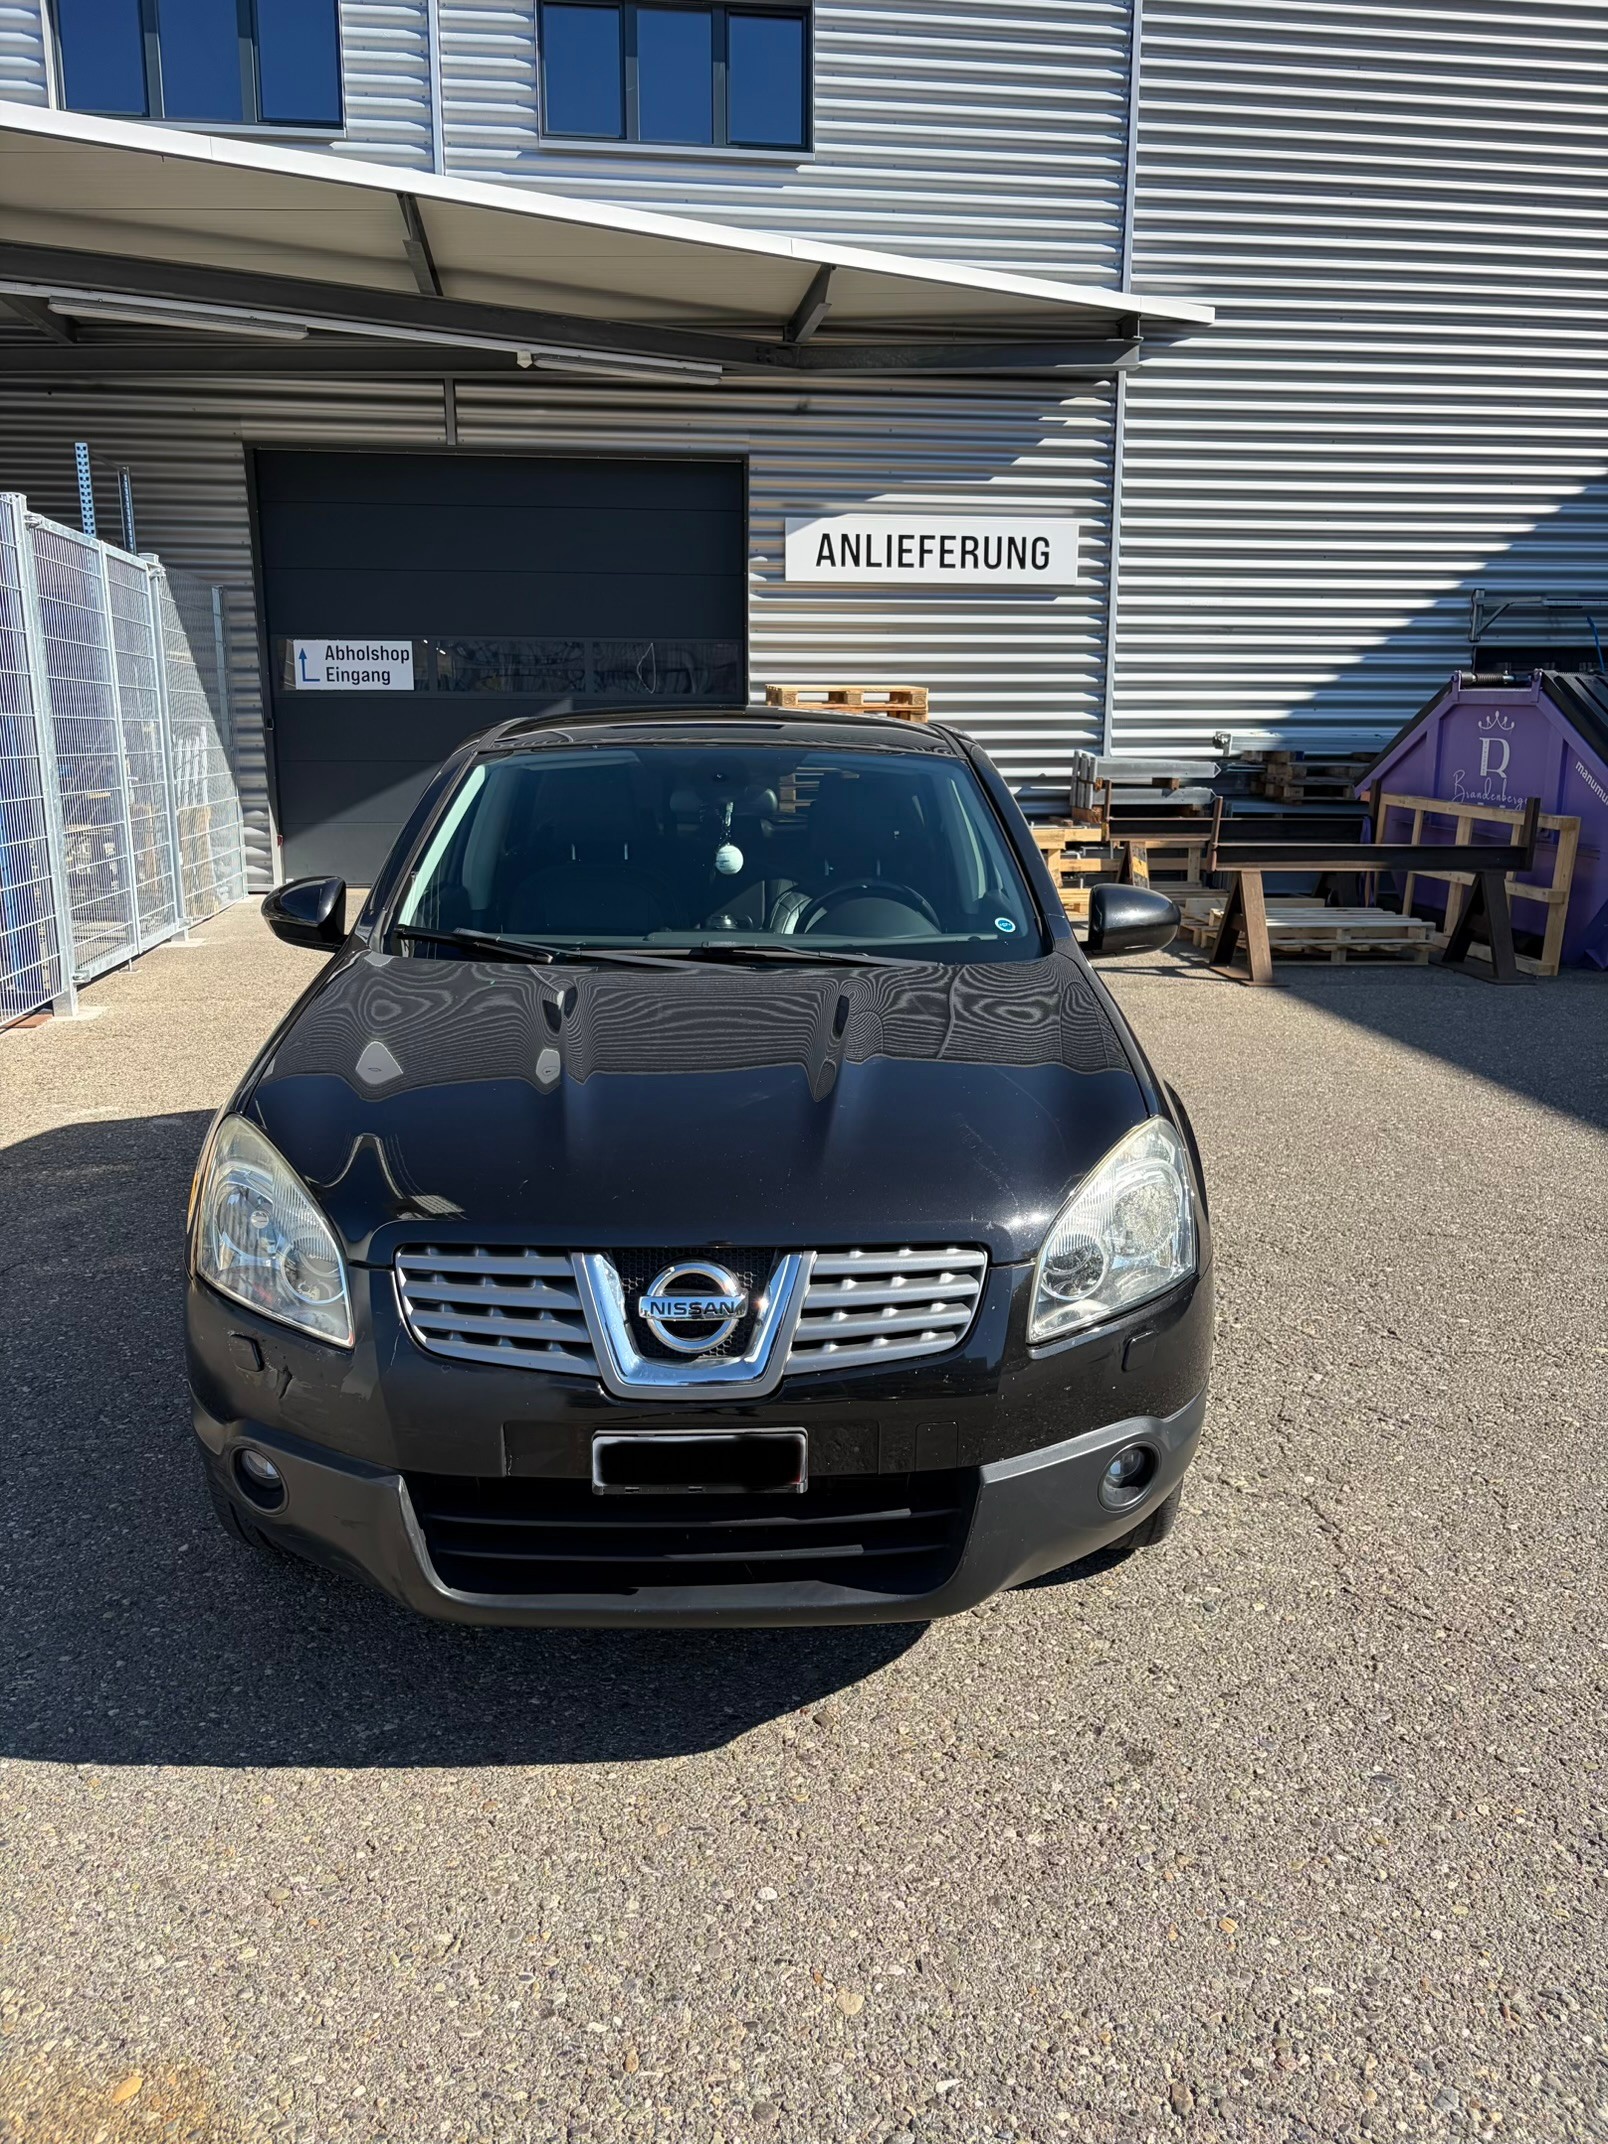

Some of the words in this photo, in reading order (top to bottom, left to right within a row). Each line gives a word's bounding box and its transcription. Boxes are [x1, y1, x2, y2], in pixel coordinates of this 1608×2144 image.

[815, 533, 1051, 571] ANLIEFERUNG
[325, 645, 410, 664] Abholshop
[326, 666, 391, 685] Eingang
[650, 1301, 735, 1315] NISSAN
